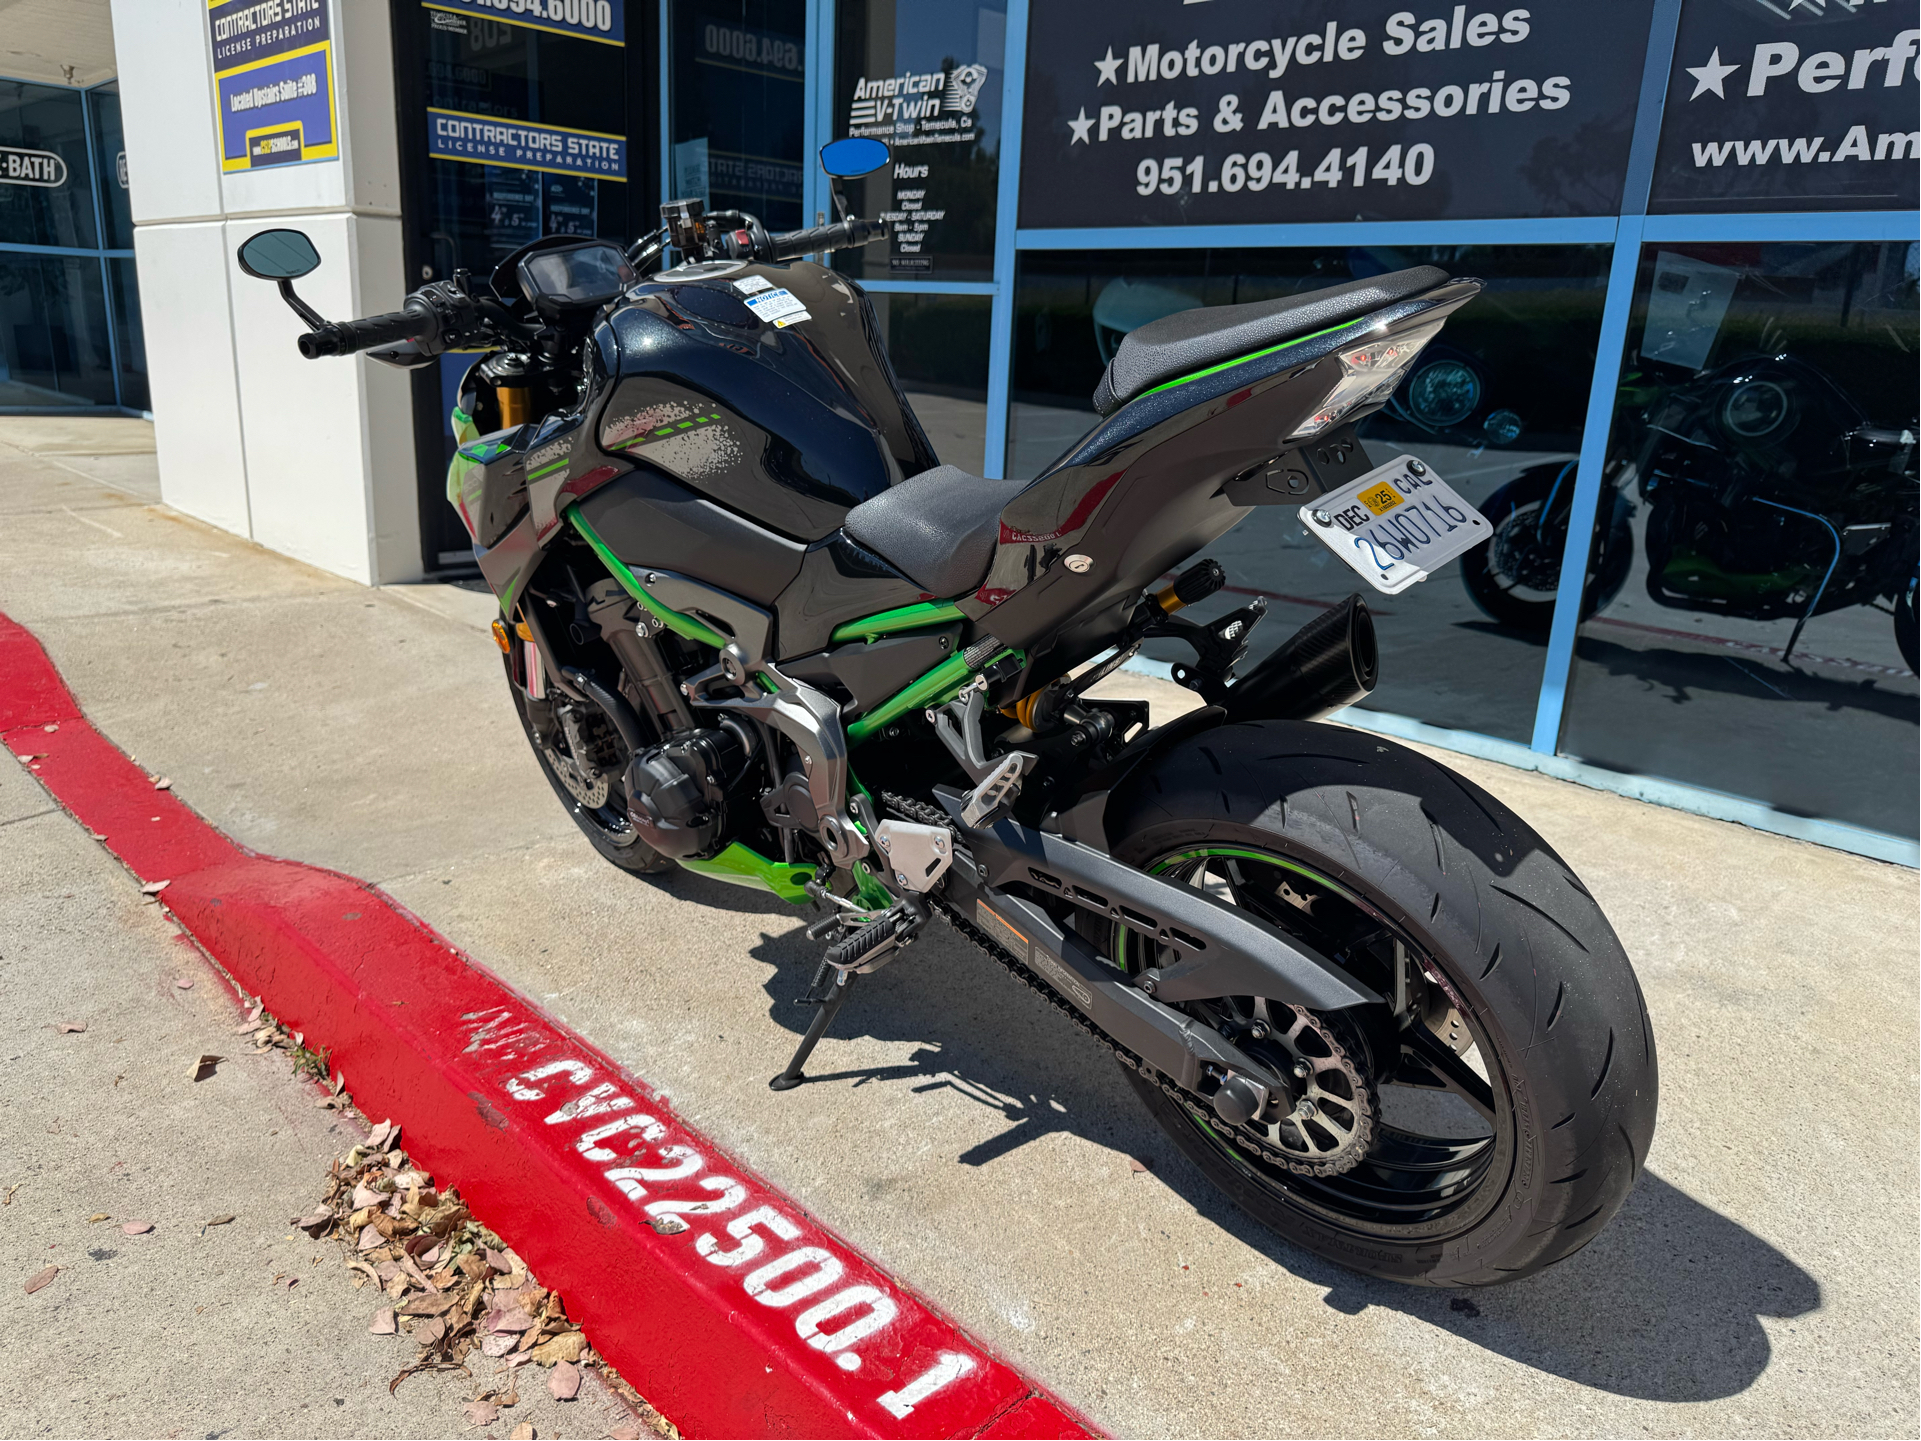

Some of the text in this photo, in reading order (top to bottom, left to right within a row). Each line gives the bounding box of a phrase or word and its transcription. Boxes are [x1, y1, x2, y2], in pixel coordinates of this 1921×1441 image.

[215, 1, 282, 41] CONTRACTORS
[217, 16, 321, 59] LICENSE PREPARATION
[1126, 5, 1530, 83] Motorcycle Sales
[1747, 28, 1921, 97] Perf
[230, 88, 254, 112] Located
[253, 83, 280, 108] Upstairs
[280, 79, 297, 101] Suite
[853, 71, 945, 100] American
[875, 94, 941, 122] V-Twin
[1098, 70, 1571, 142] Parts & Accessories
[437, 118, 619, 160] CONTRACTORS STATE
[849, 125, 894, 137] Performance
[895, 121, 915, 134] Shop
[960, 116, 972, 127] Ca
[438, 138, 619, 171] LICENSE PREPARATION
[893, 162, 929, 179] Hours
[1135, 143, 1435, 196] 951.694.4140
[897, 189, 926, 200] MONDAY
[901, 200, 922, 210] Closed
[880, 210, 908, 221] TUESDAY
[910, 210, 945, 221] SATURDAY
[897, 232, 925, 242] SUNDAY
[900, 243, 921, 252] Closed
[1375, 489, 1392, 505] 25
[1393, 473, 1433, 495] CAL
[1334, 504, 1370, 531] DEC
[1354, 495, 1467, 570] 26W0716
